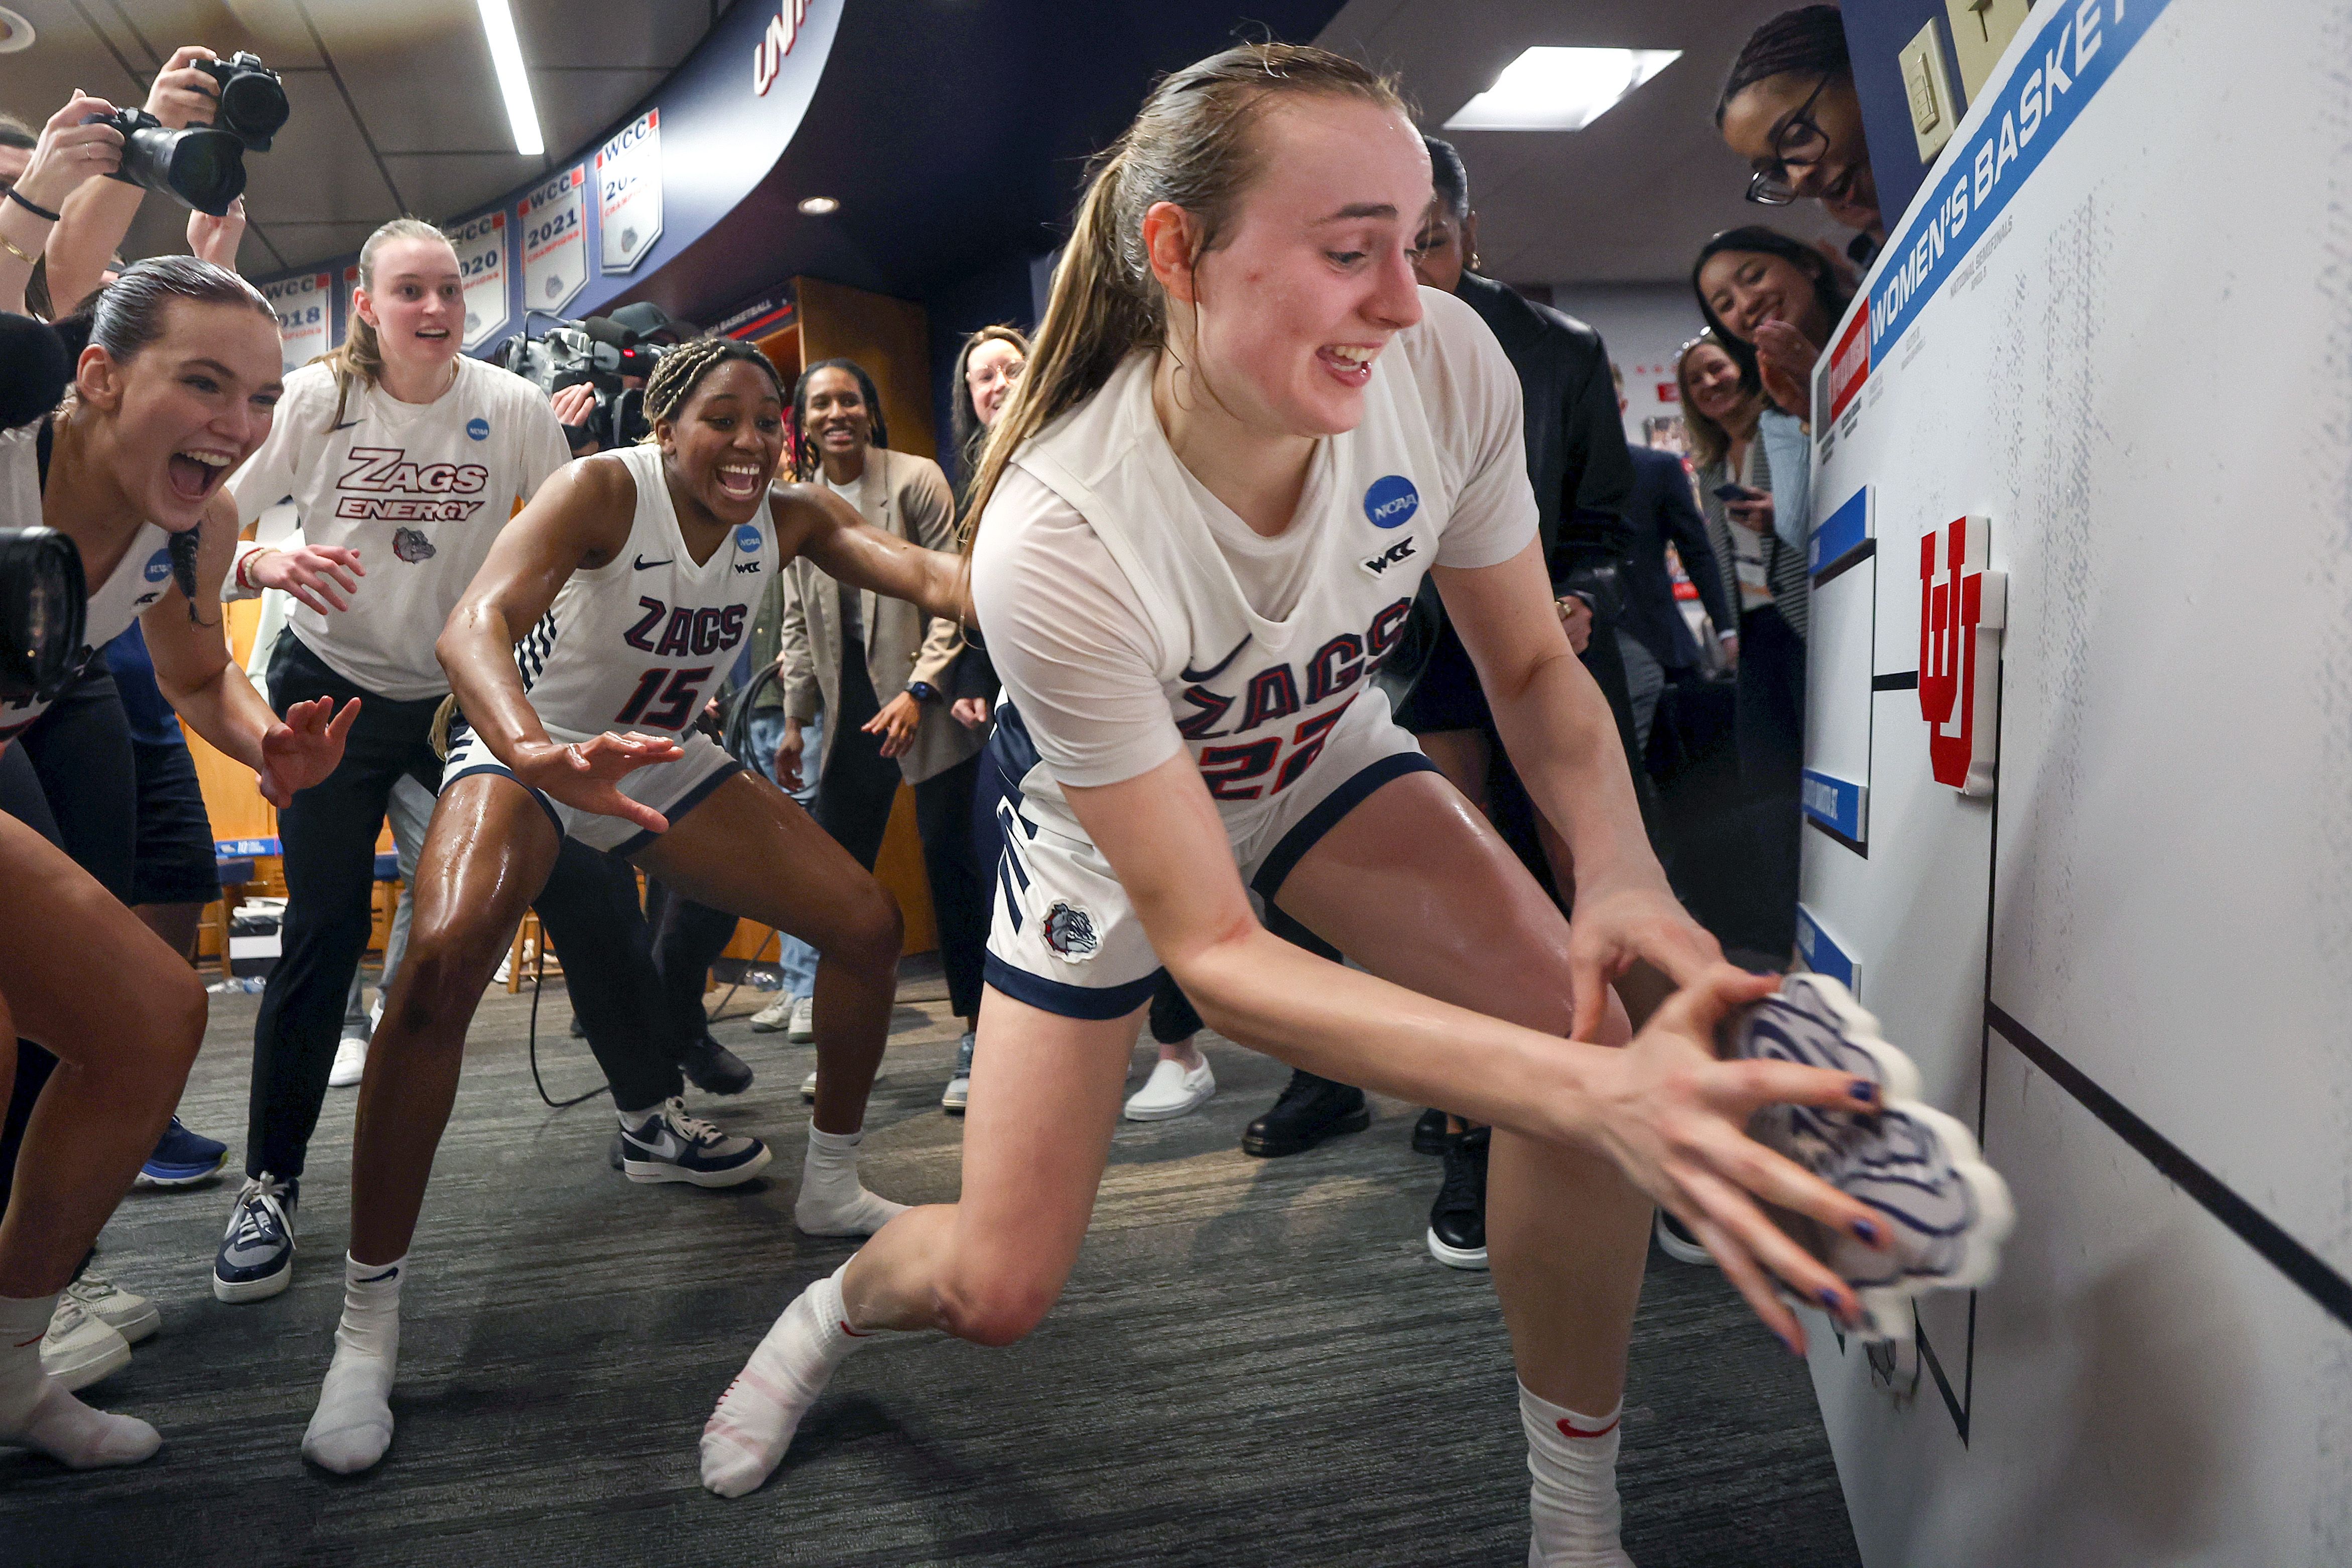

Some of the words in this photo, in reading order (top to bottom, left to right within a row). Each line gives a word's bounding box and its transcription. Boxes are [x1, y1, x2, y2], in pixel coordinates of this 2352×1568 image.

[605, 118, 646, 161] WCC
[531, 176, 570, 208] WCC
[528, 208, 577, 249] 2021
[460, 250, 497, 276] 020
[1871, 175, 1968, 345] WOMEN'S
[265, 278, 314, 300] WCC
[279, 307, 320, 327] 018
[469, 427, 488, 436] NCAA
[336, 446, 489, 494] ZAGS
[336, 496, 485, 521] ENERGY
[1374, 494, 1418, 521] NCAA
[740, 537, 760, 547] NCAA
[1365, 536, 1417, 574] WCC
[734, 561, 761, 574] WCC
[623, 596, 747, 657] ZAGS
[1175, 596, 1411, 740] ZAGS
[614, 666, 714, 732] 15
